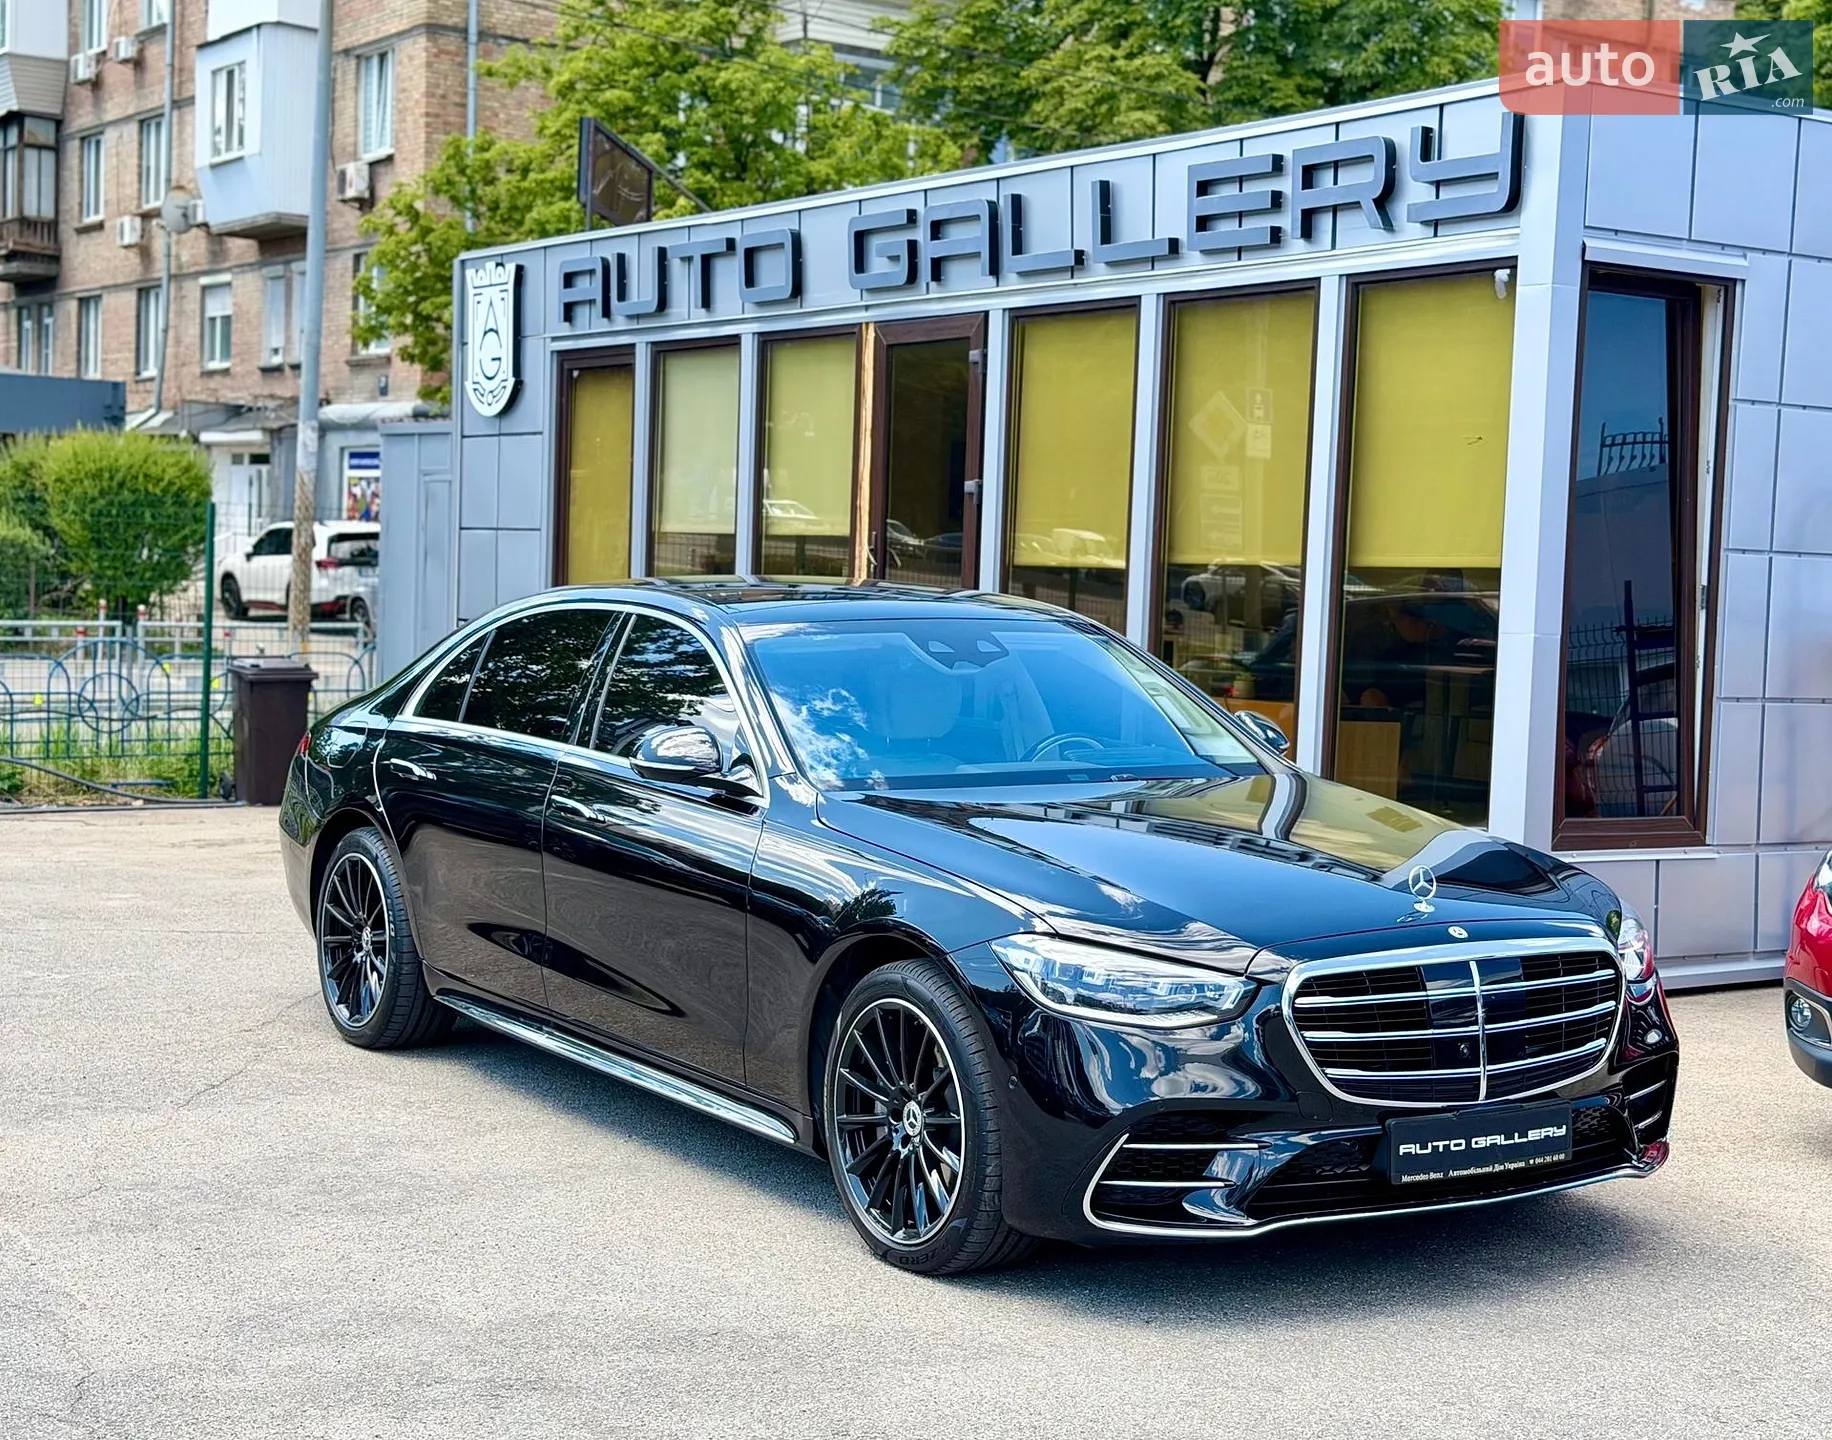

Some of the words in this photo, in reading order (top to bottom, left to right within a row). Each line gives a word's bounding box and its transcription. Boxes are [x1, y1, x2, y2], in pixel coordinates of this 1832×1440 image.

[558, 228, 802, 325] AUTO
[848, 111, 1525, 290] GALLERY
[1399, 1139, 1466, 1155] AUTO
[1471, 1124, 1567, 1148] GALLERY
